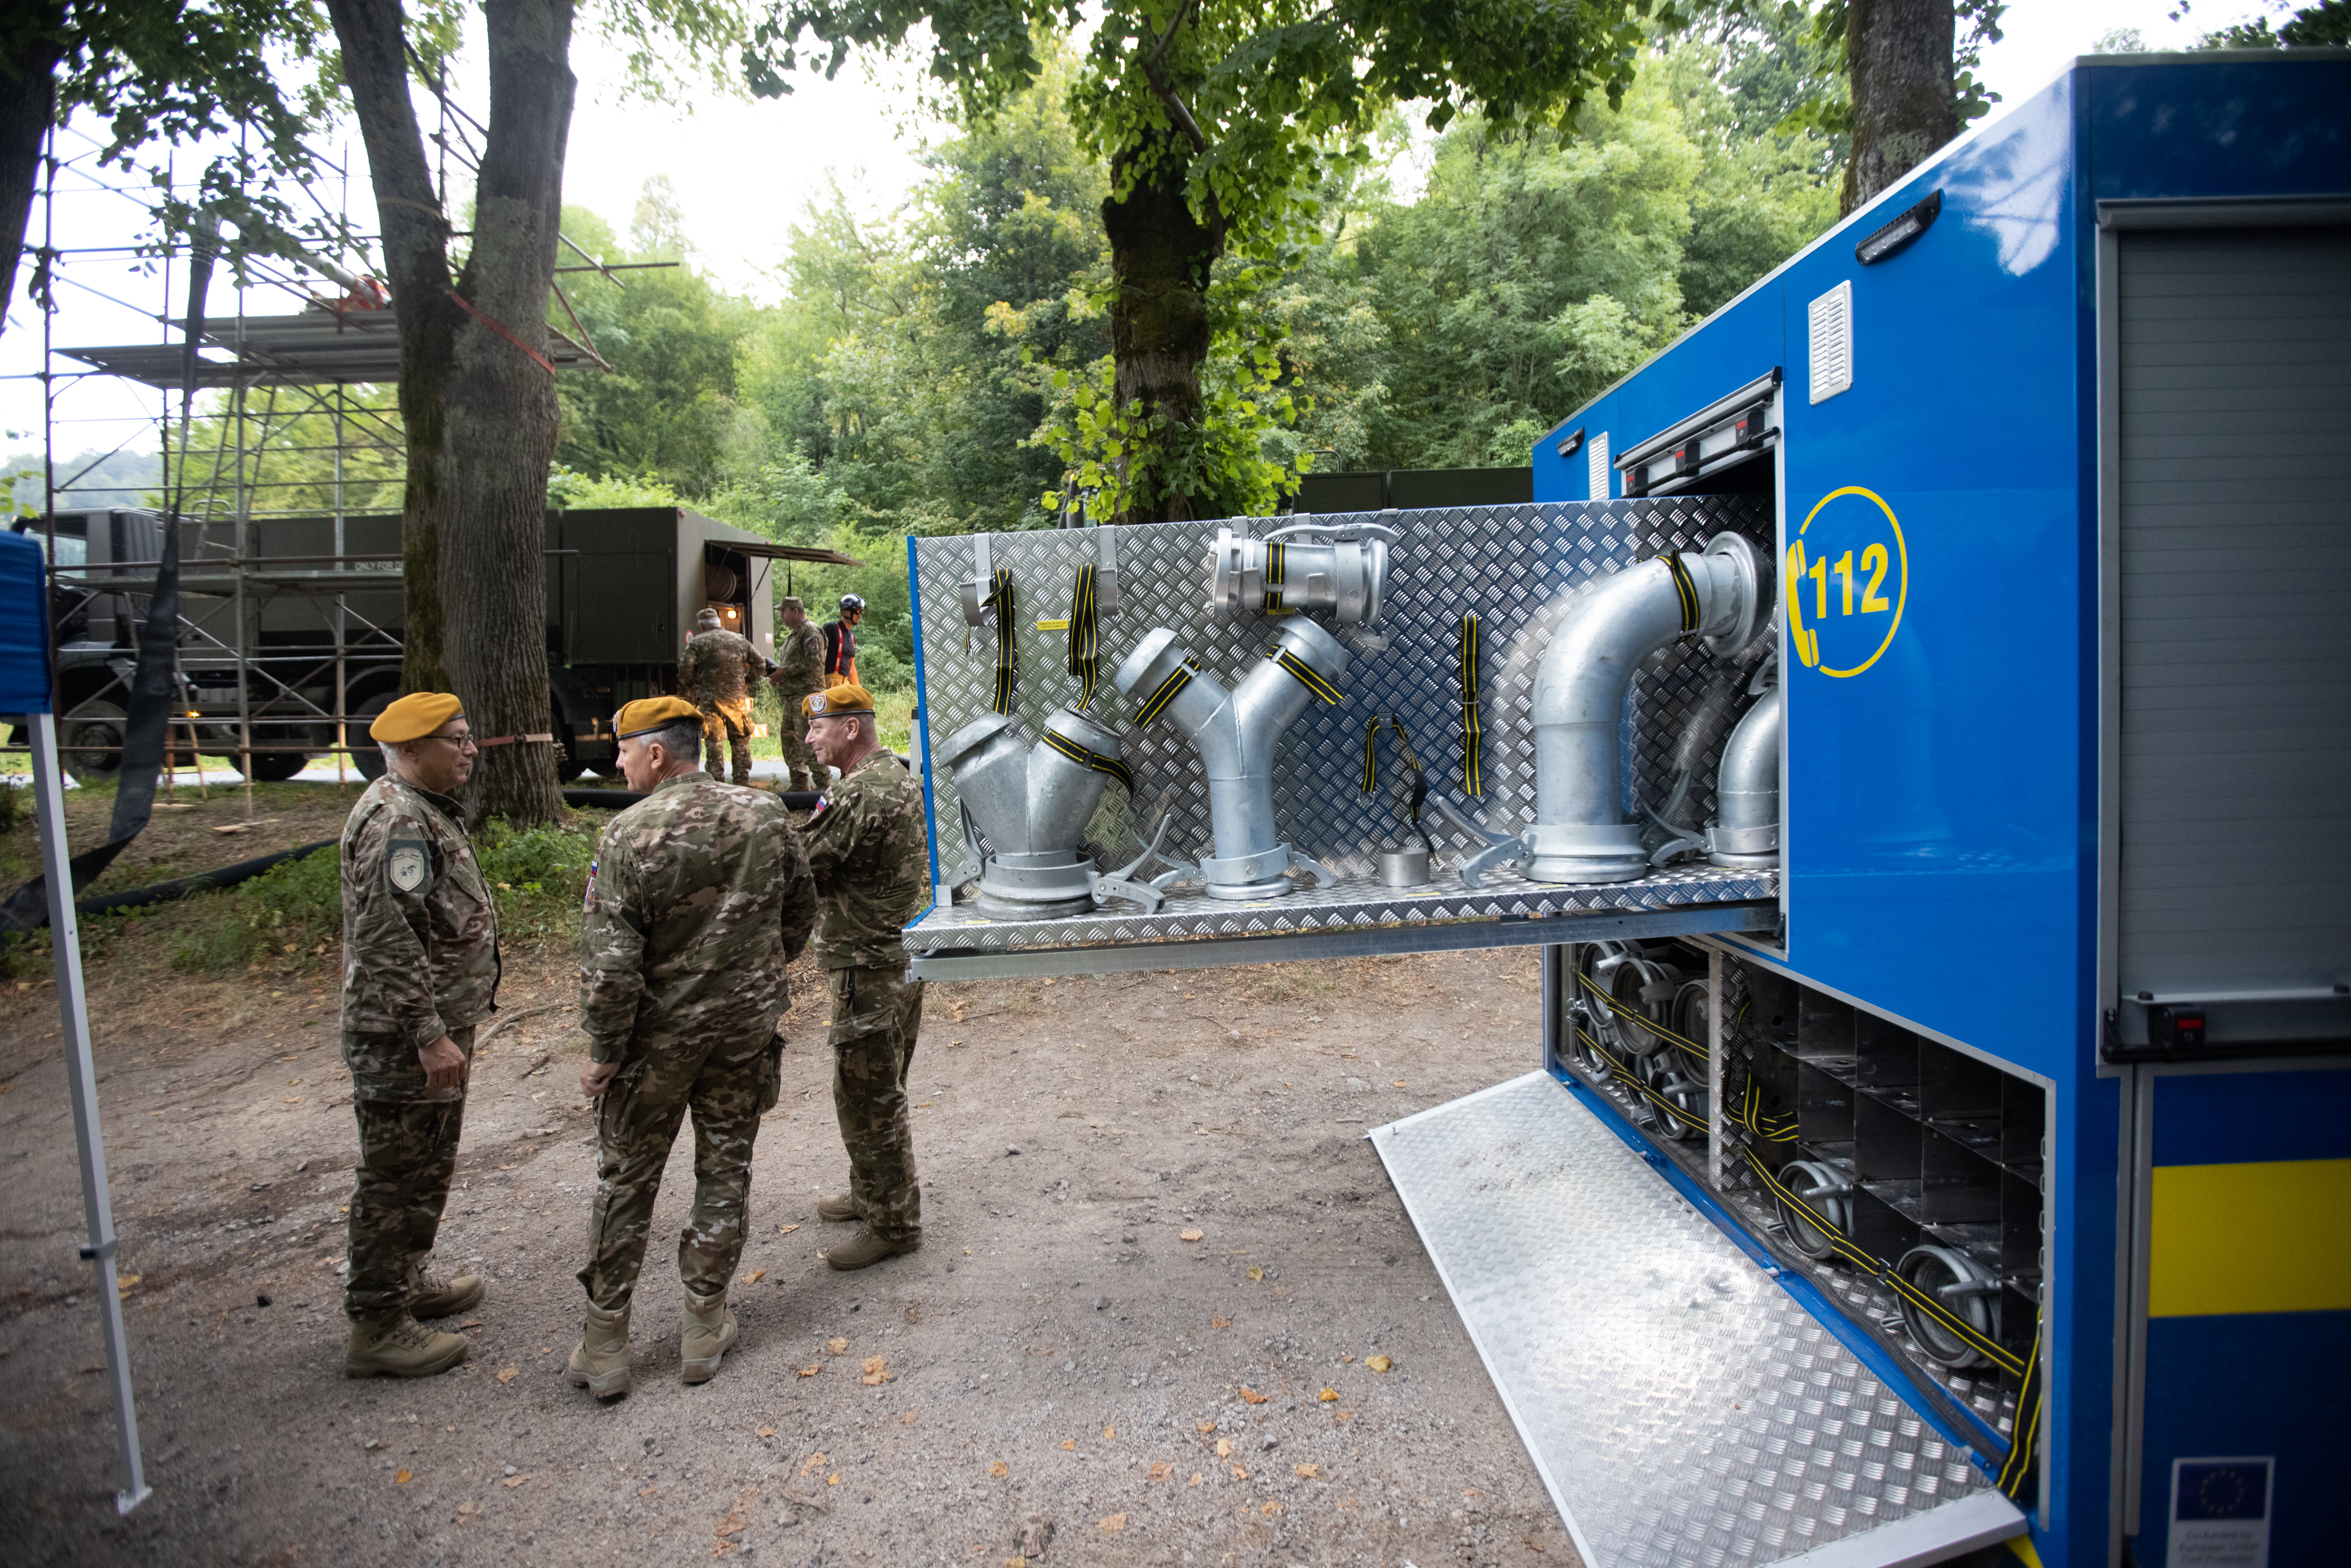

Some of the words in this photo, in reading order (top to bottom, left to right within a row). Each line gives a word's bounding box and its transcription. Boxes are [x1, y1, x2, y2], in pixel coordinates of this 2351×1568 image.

[355, 562, 375, 571] ONLY
[377, 561, 393, 570] FOR
[1809, 543, 1889, 619] 112
